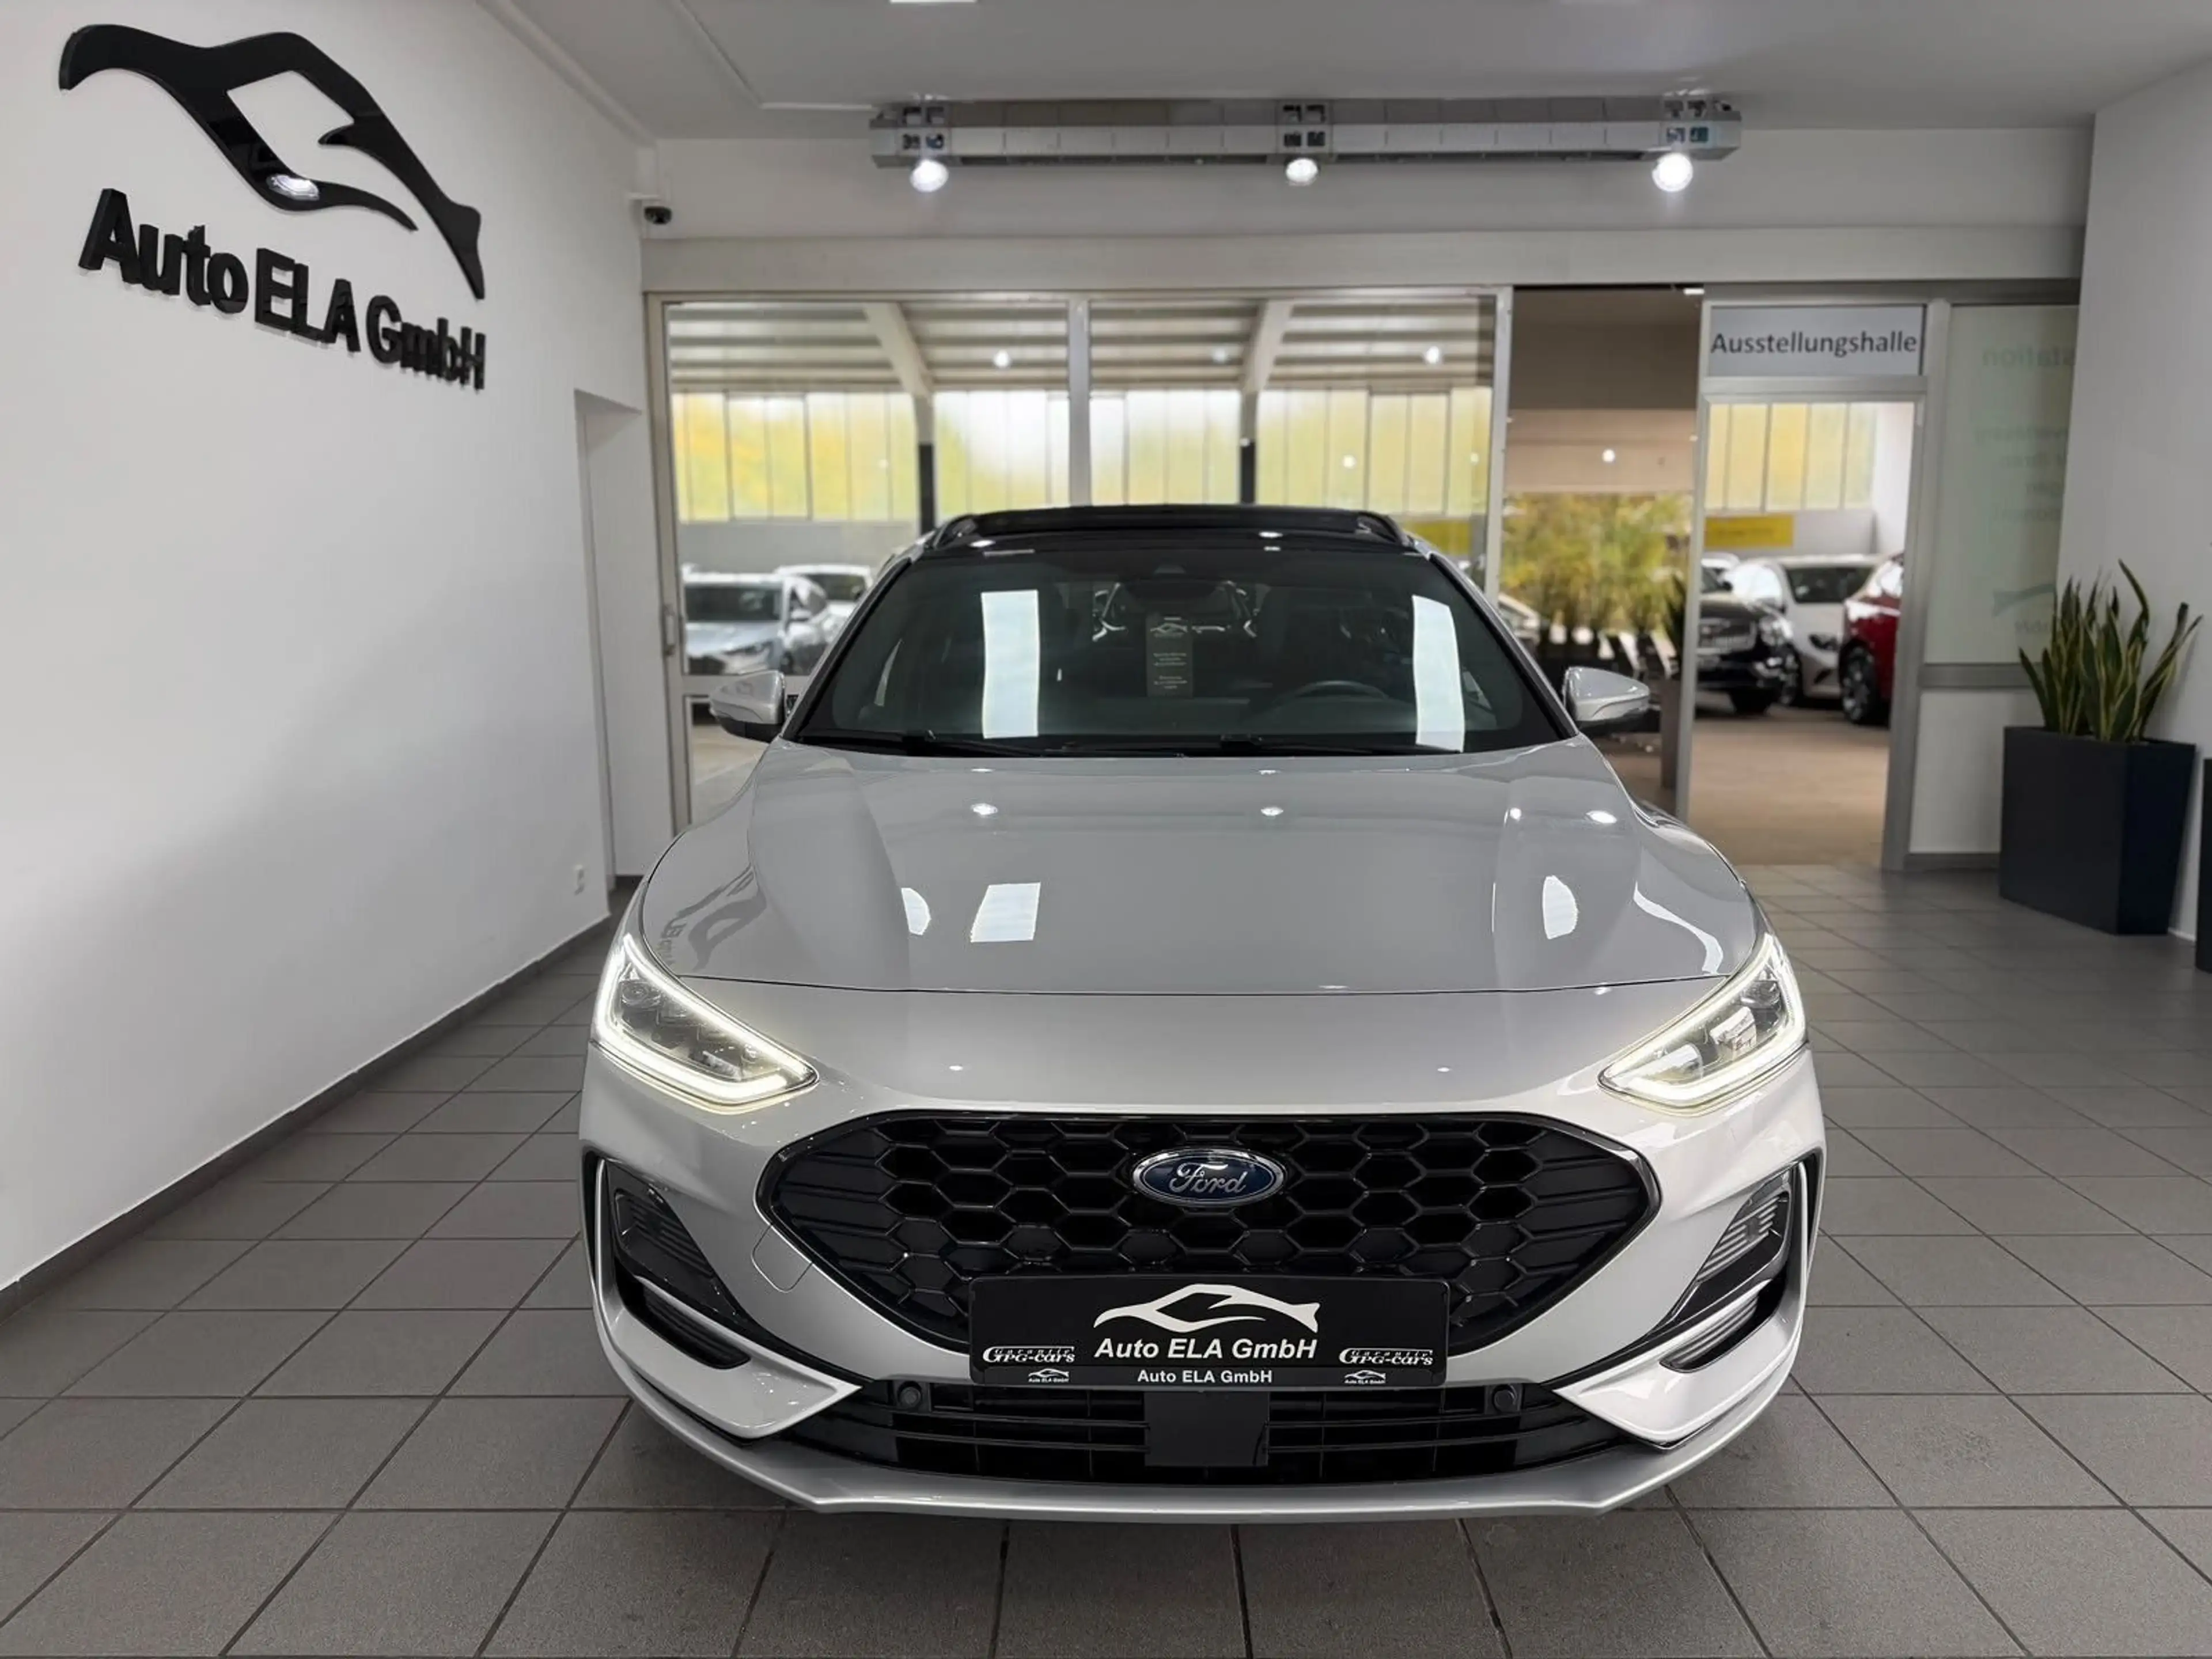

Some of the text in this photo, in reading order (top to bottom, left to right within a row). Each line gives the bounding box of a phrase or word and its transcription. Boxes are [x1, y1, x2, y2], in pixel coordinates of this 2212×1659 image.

[78, 188, 486, 391] Auto ELA GmbH
[1711, 330, 1917, 357] Ausstellungshalle
[1169, 1162, 1248, 1194] Ford
[1094, 1338, 1317, 1358] Auto ELA GmbH
[1137, 1370, 1272, 1382] Auto ELA GmbH
